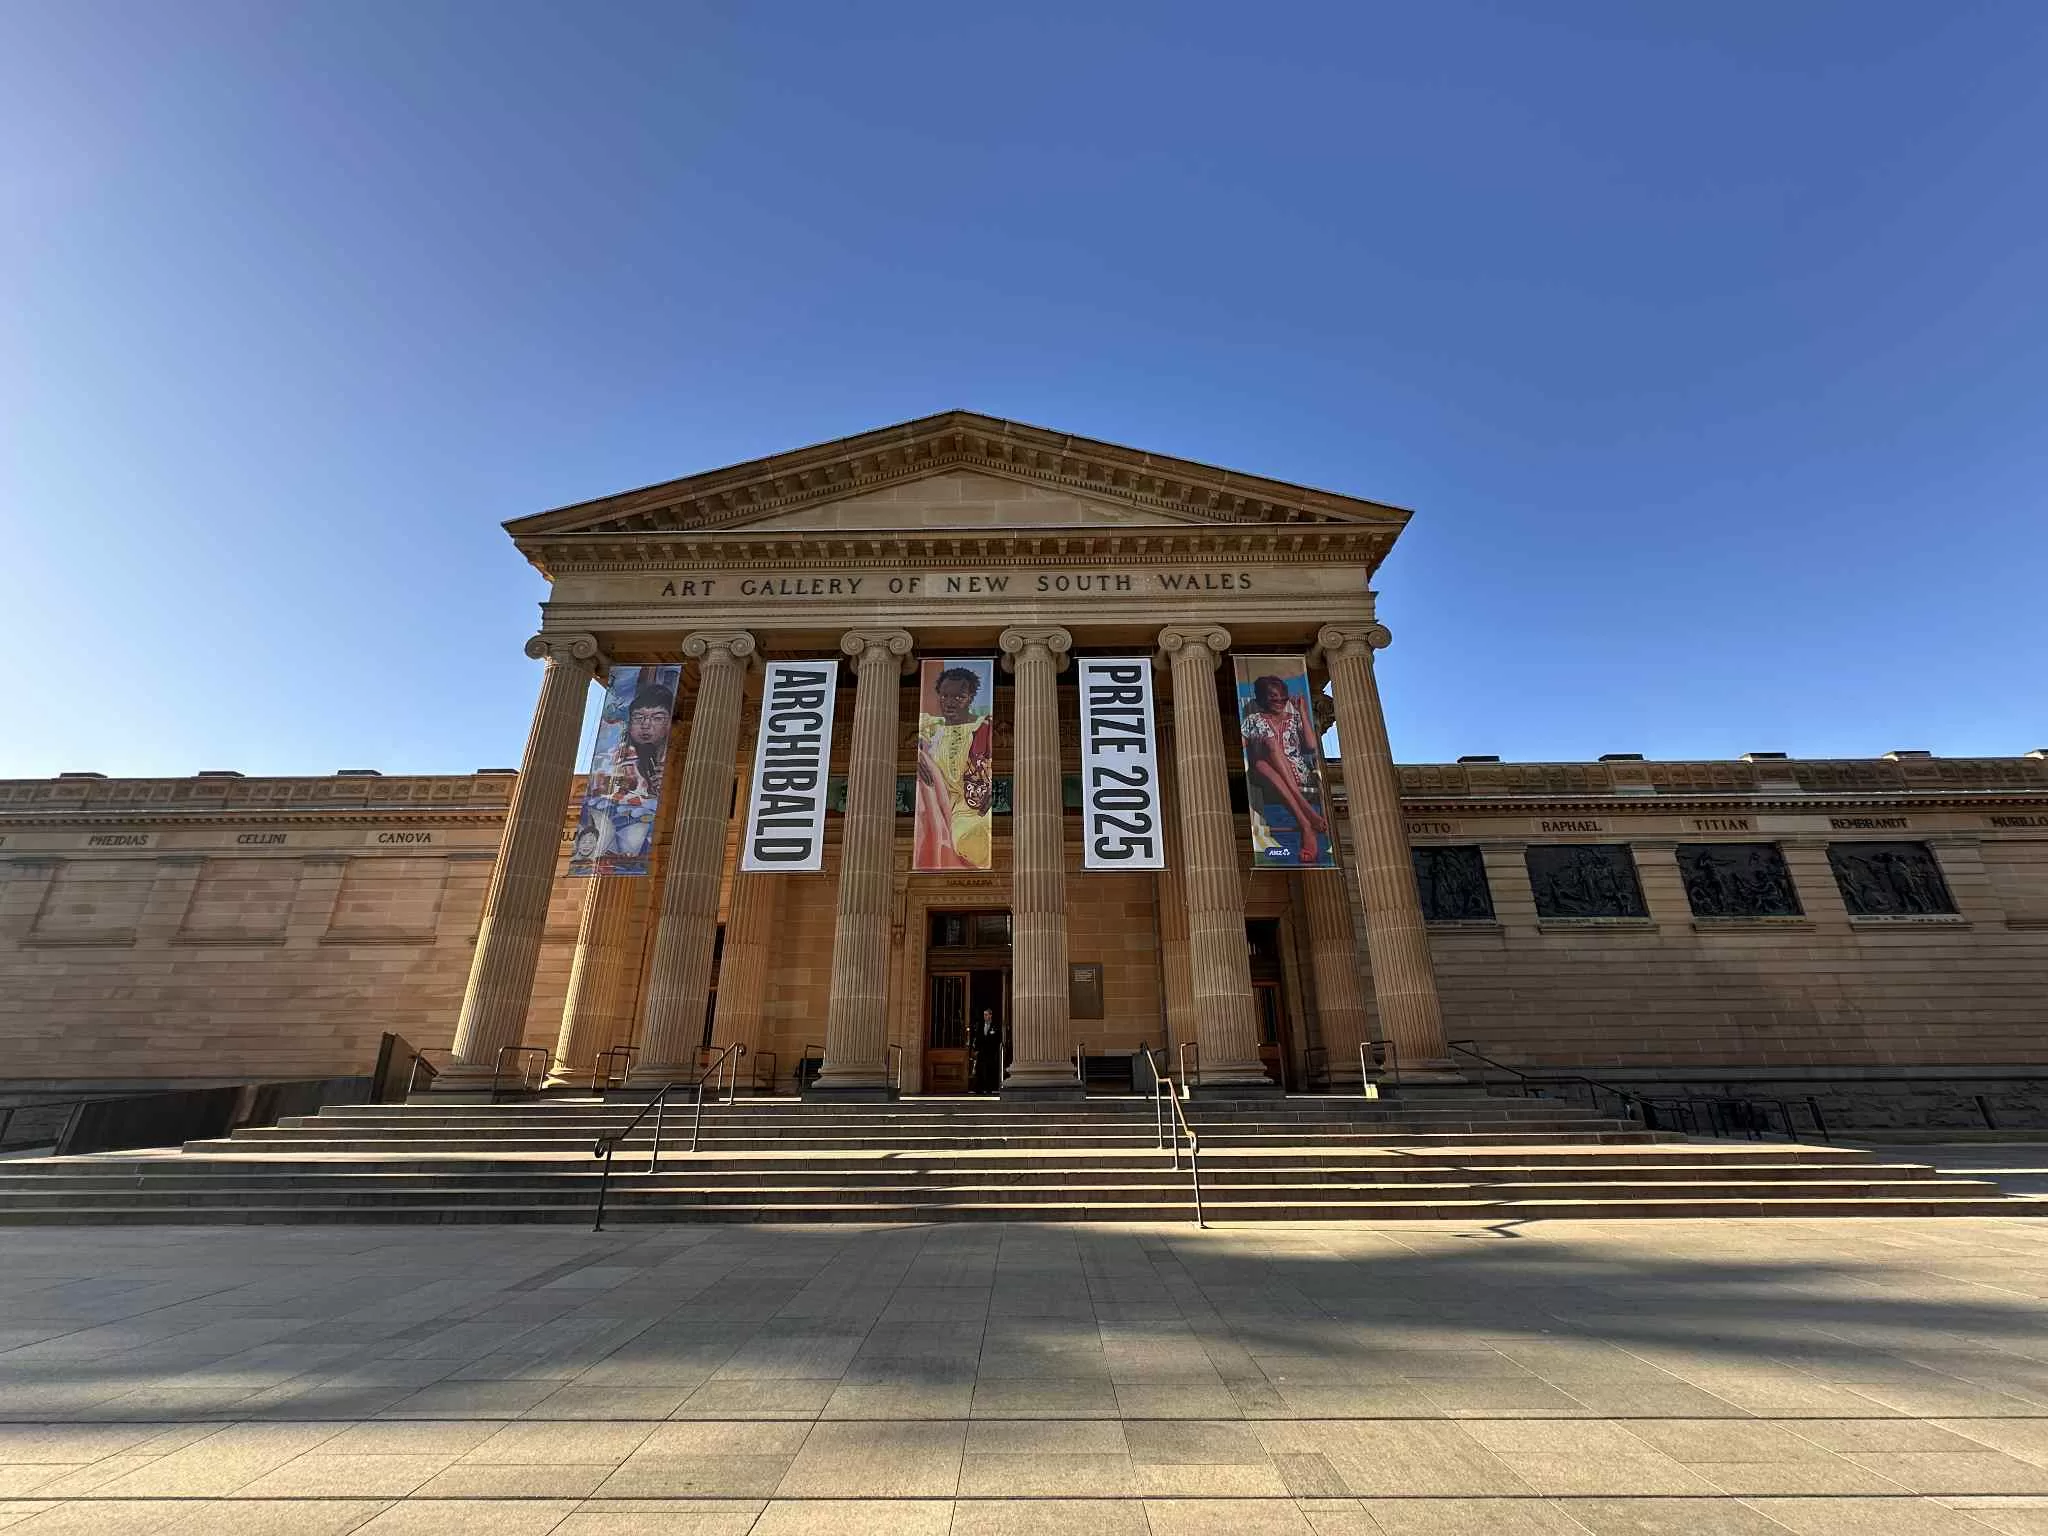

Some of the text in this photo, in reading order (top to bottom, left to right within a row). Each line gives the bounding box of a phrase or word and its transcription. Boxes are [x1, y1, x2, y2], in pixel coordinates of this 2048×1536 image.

[661, 573, 1253, 598] ART GALLERY OF NEW SOUTH WALES
[753, 669, 828, 863] ARCHIBALD
[1087, 665, 1154, 861] PRIZE 2025
[1406, 822, 1451, 834] IOTTO
[1541, 820, 1603, 833] RAPHAEL
[1693, 818, 1749, 831] TITIAN
[1829, 817, 1910, 829] REMBRANDT
[236, 833, 288, 845] CELLINI
[378, 832, 432, 844] CANOVA
